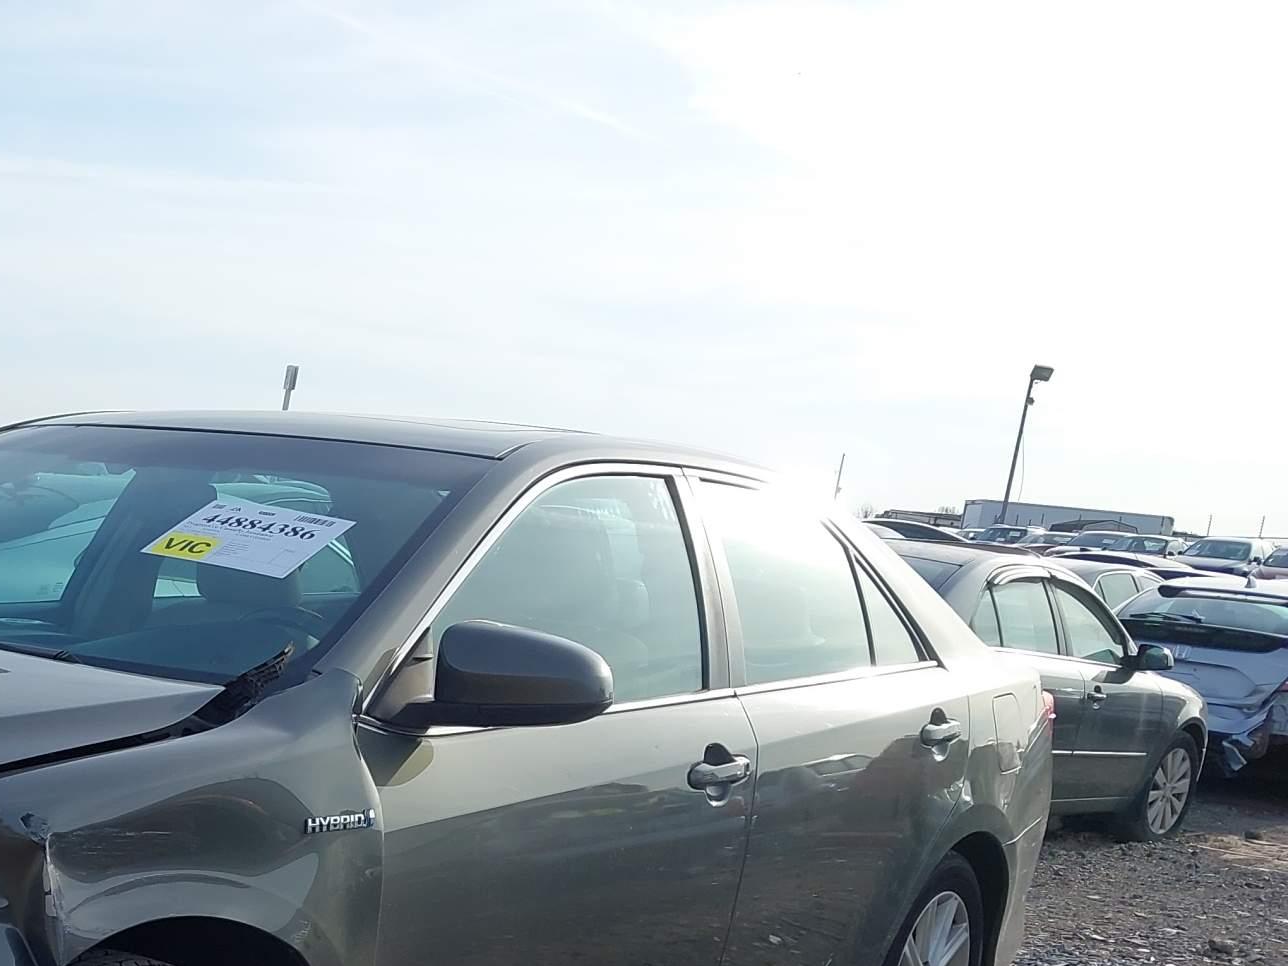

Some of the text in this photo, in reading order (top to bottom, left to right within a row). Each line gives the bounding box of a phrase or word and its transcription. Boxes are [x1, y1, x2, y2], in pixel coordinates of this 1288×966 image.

[202, 513, 320, 540] 44884386
[164, 537, 212, 554] VIC
[305, 812, 367, 833] HYBRID
